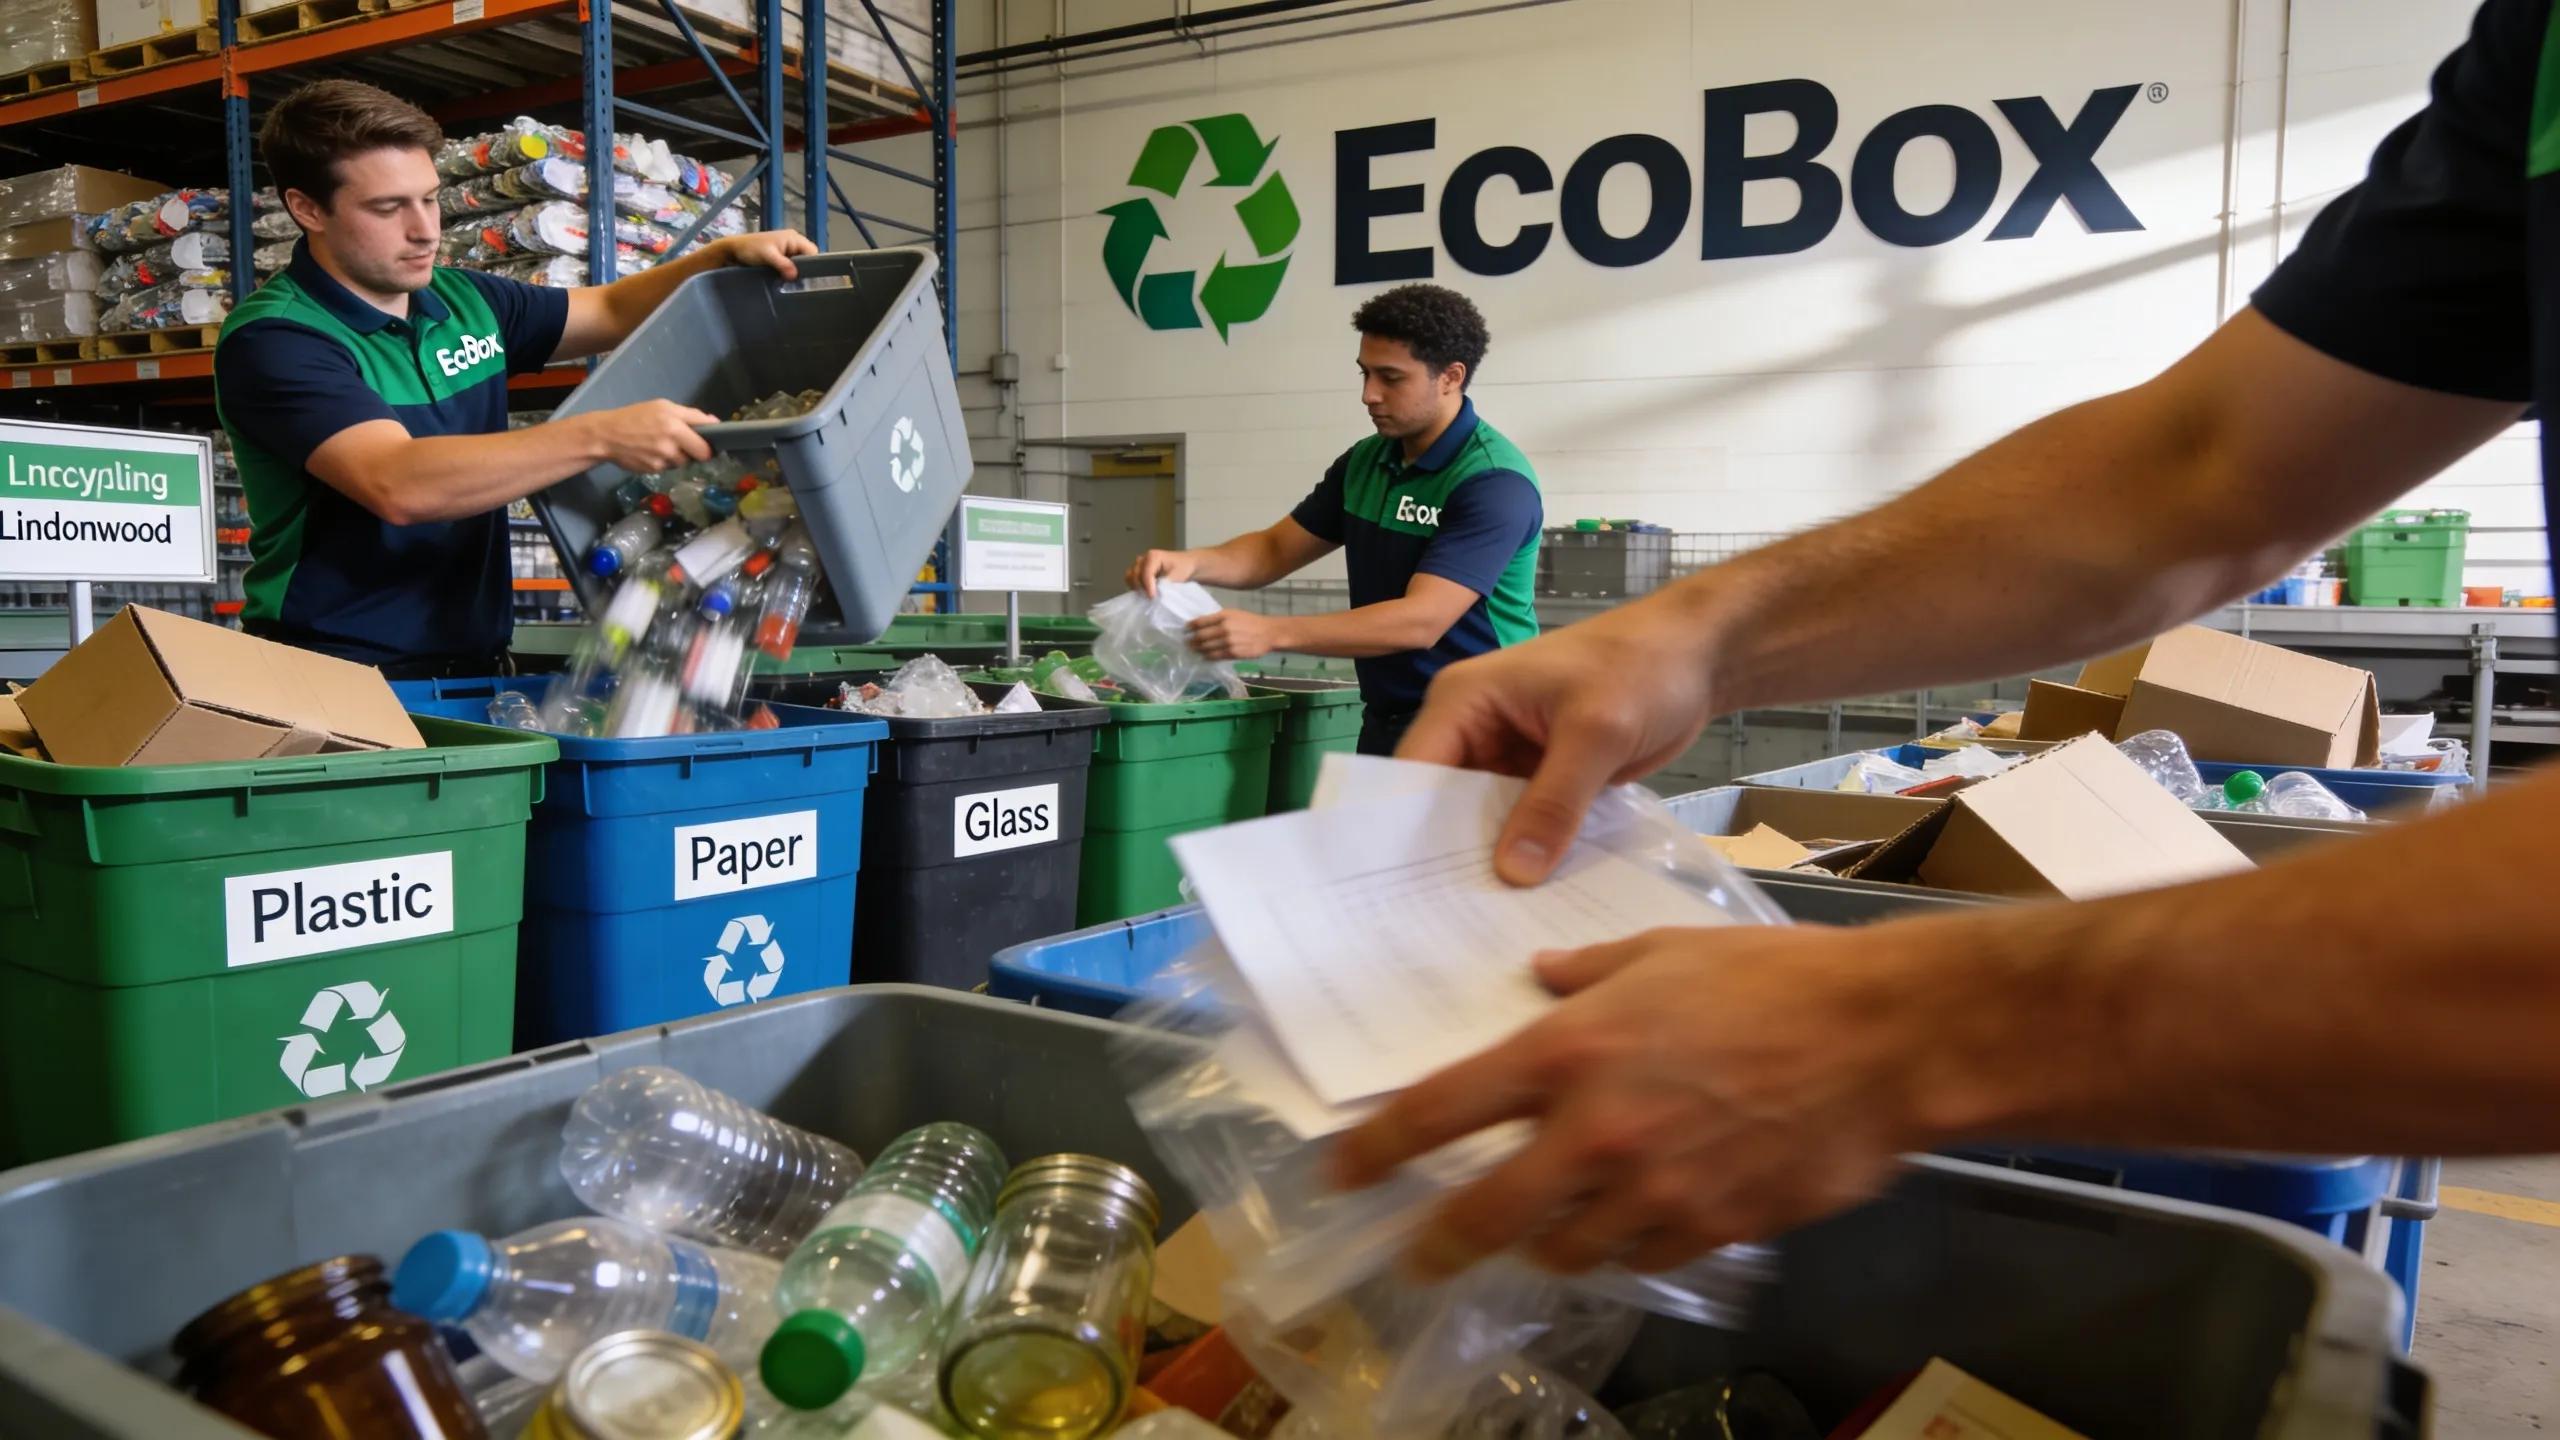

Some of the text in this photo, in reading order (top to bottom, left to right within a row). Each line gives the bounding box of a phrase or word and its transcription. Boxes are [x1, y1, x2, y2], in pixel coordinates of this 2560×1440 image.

[0, 510, 172, 544] Lindonwood
[964, 798, 1050, 842] Glass
[690, 829, 804, 884] Paper
[253, 871, 434, 943] Plastic
